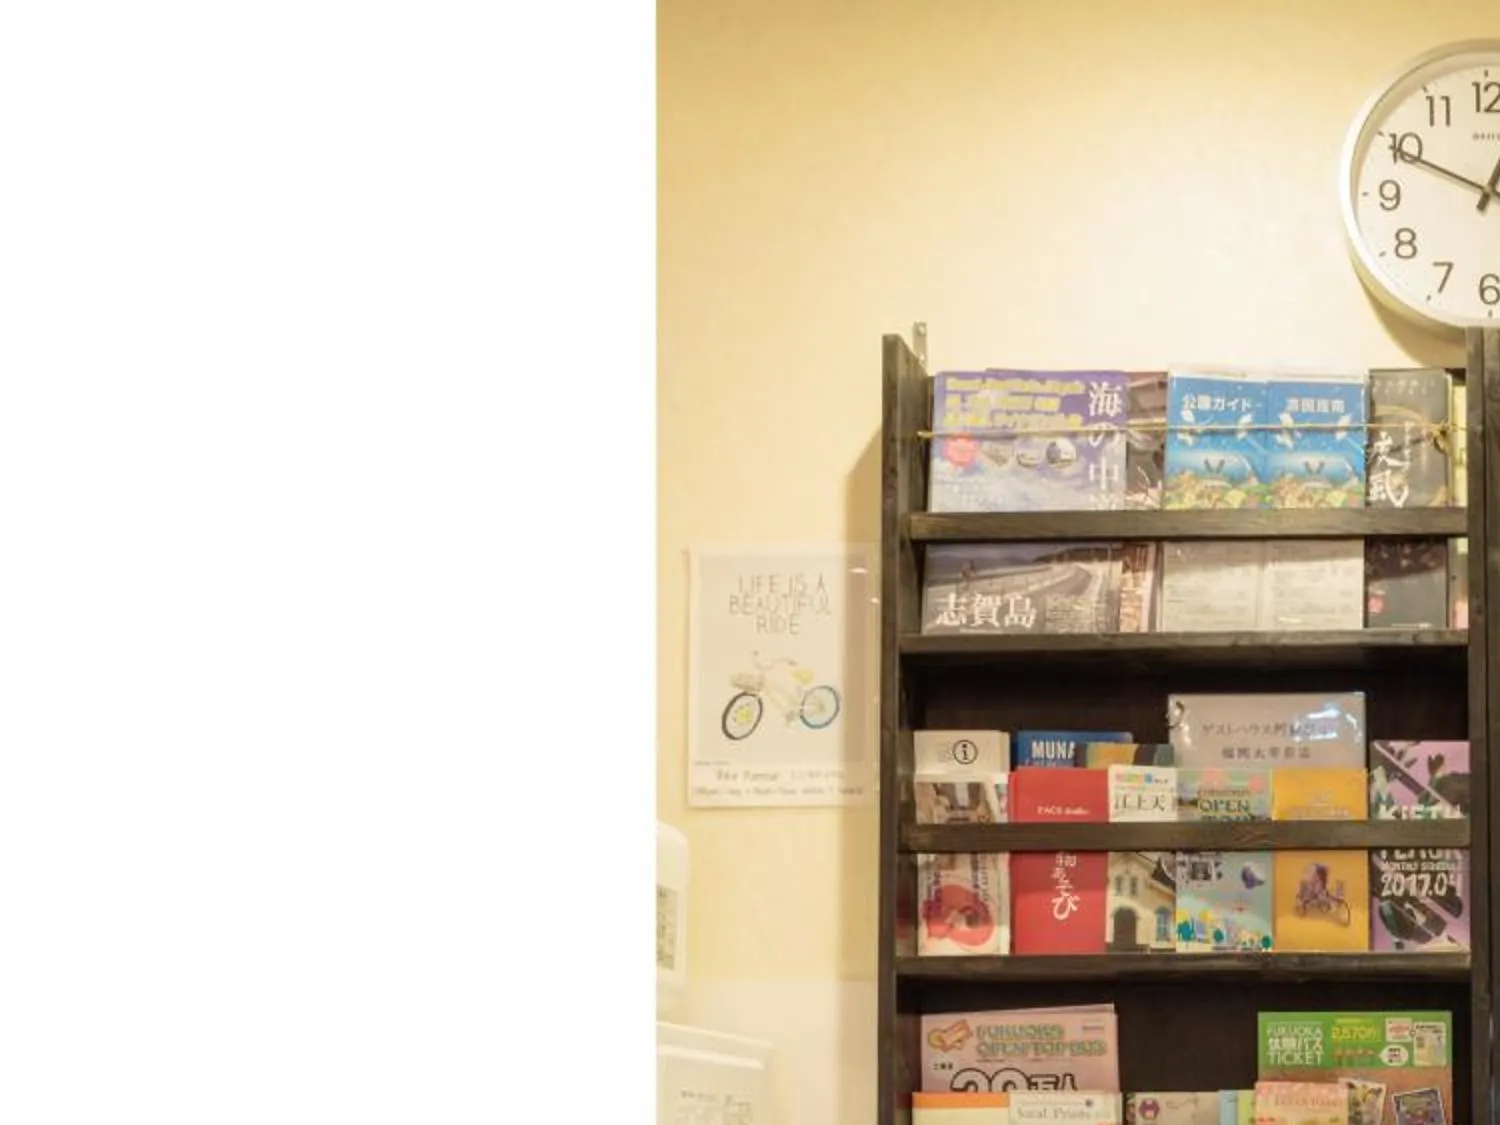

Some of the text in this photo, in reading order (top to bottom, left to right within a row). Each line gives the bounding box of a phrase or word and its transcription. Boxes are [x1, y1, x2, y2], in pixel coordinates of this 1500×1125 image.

[1425, 95, 1452, 127] 11
[1389, 131, 1423, 164] 10
[1378, 180, 1401, 210] 9
[1394, 227, 1418, 259] 8
[1432, 262, 1454, 293] 7
[738, 573, 776, 594] LIFE
[755, 614, 801, 635] RIDE
[934, 592, 1037, 629] 志賀島
[1381, 871, 1463, 897] 2017.04
[1268, 1052, 1323, 1065] TICKET
